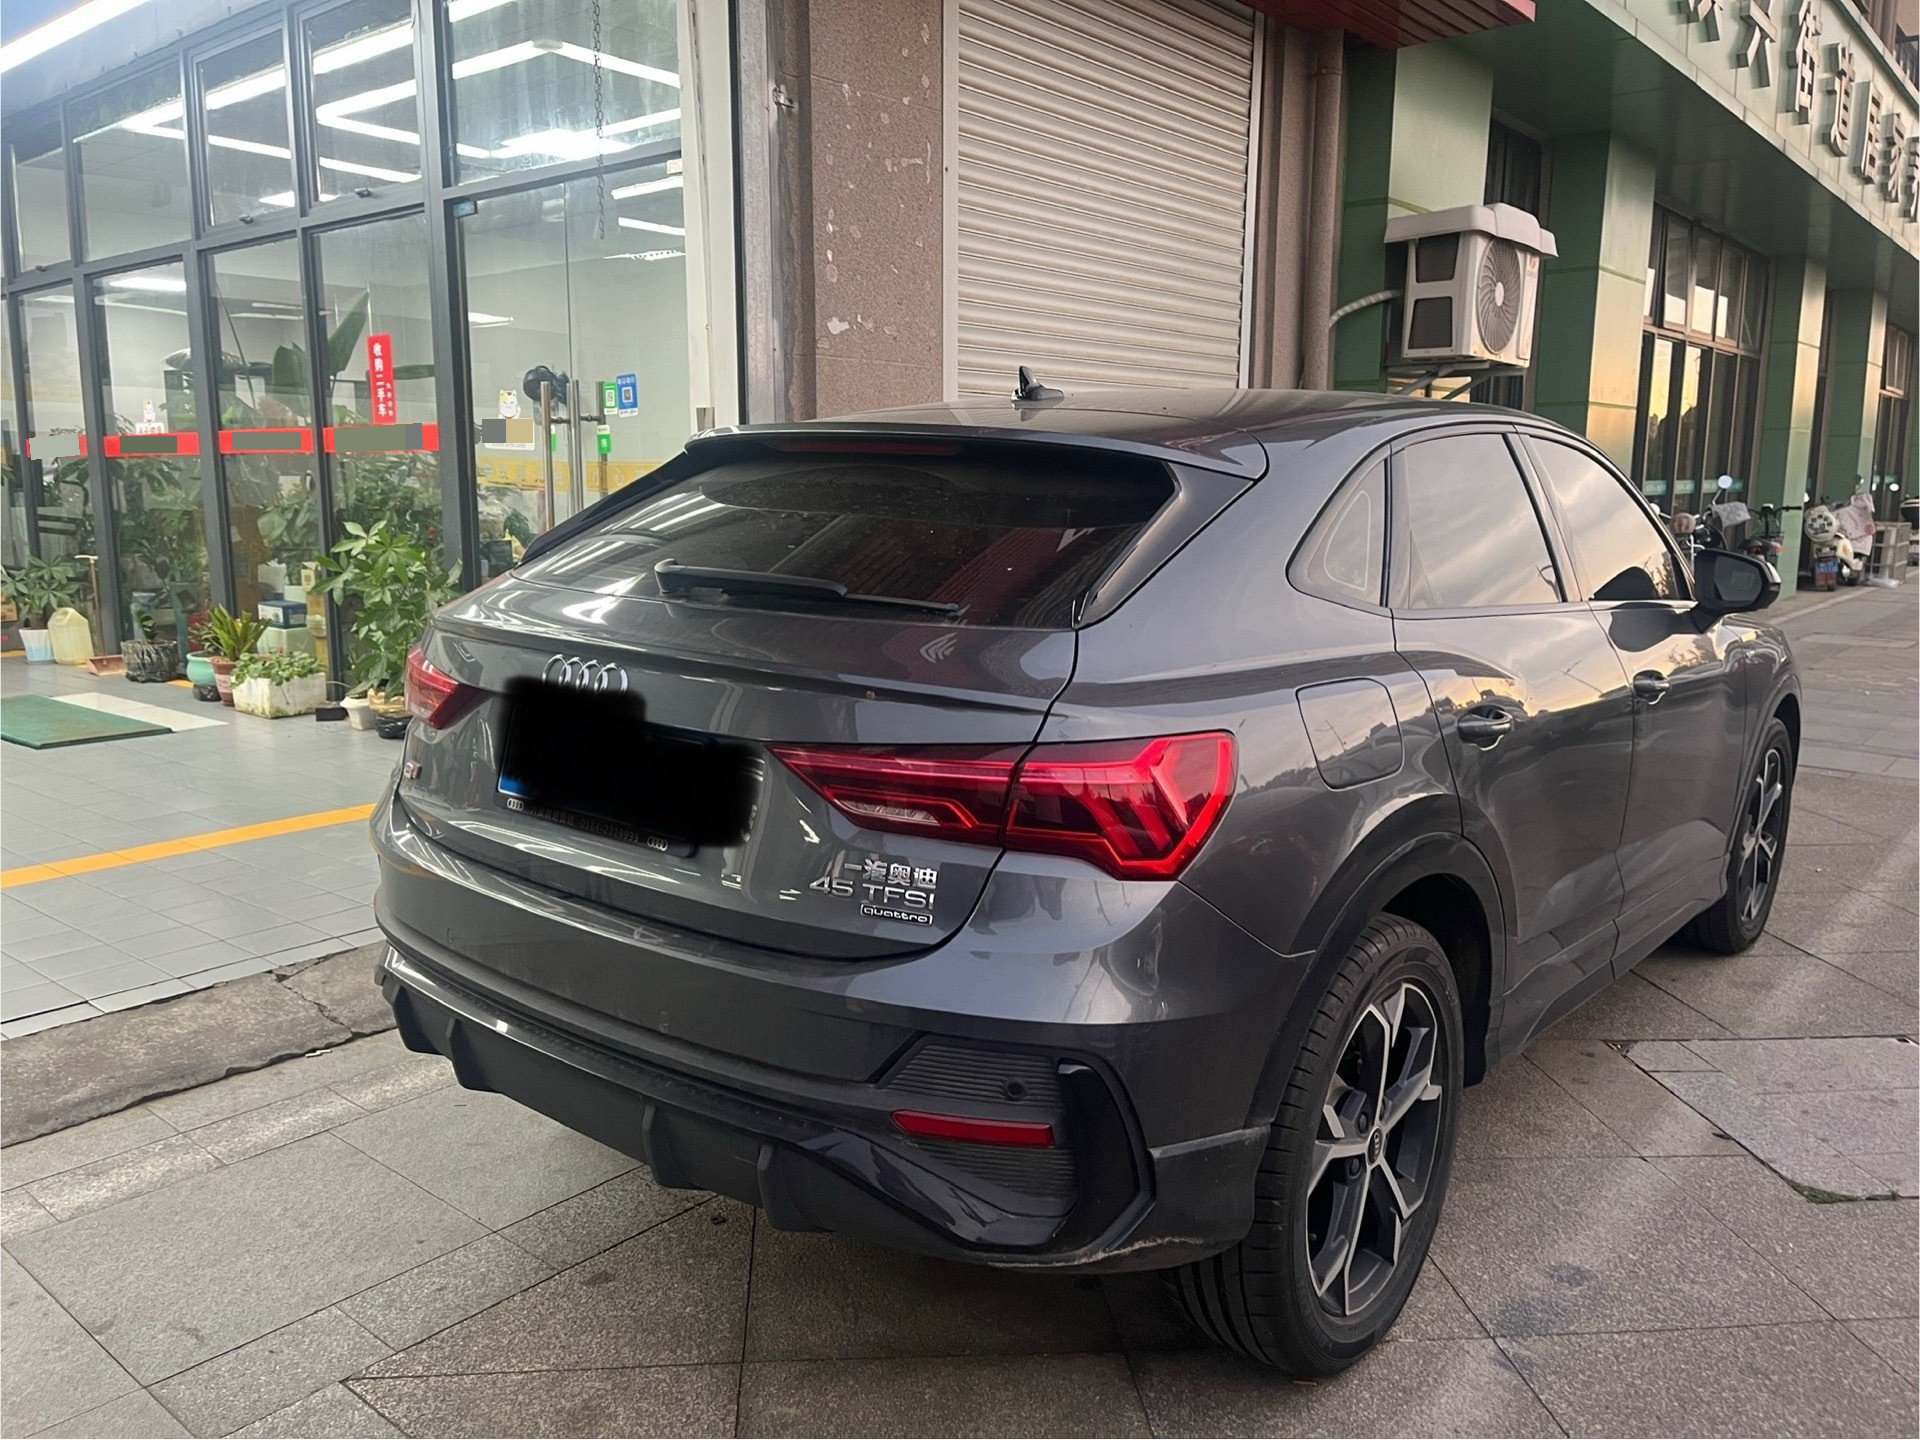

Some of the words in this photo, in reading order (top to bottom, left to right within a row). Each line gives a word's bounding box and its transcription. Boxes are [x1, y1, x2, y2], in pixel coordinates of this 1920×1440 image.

[372, 342, 387, 417] 收购二手车
[844, 858, 938, 889] 一汽奥迪
[809, 876, 854, 897] 45
[862, 883, 935, 910] TFSI
[862, 906, 930, 925] quattro
